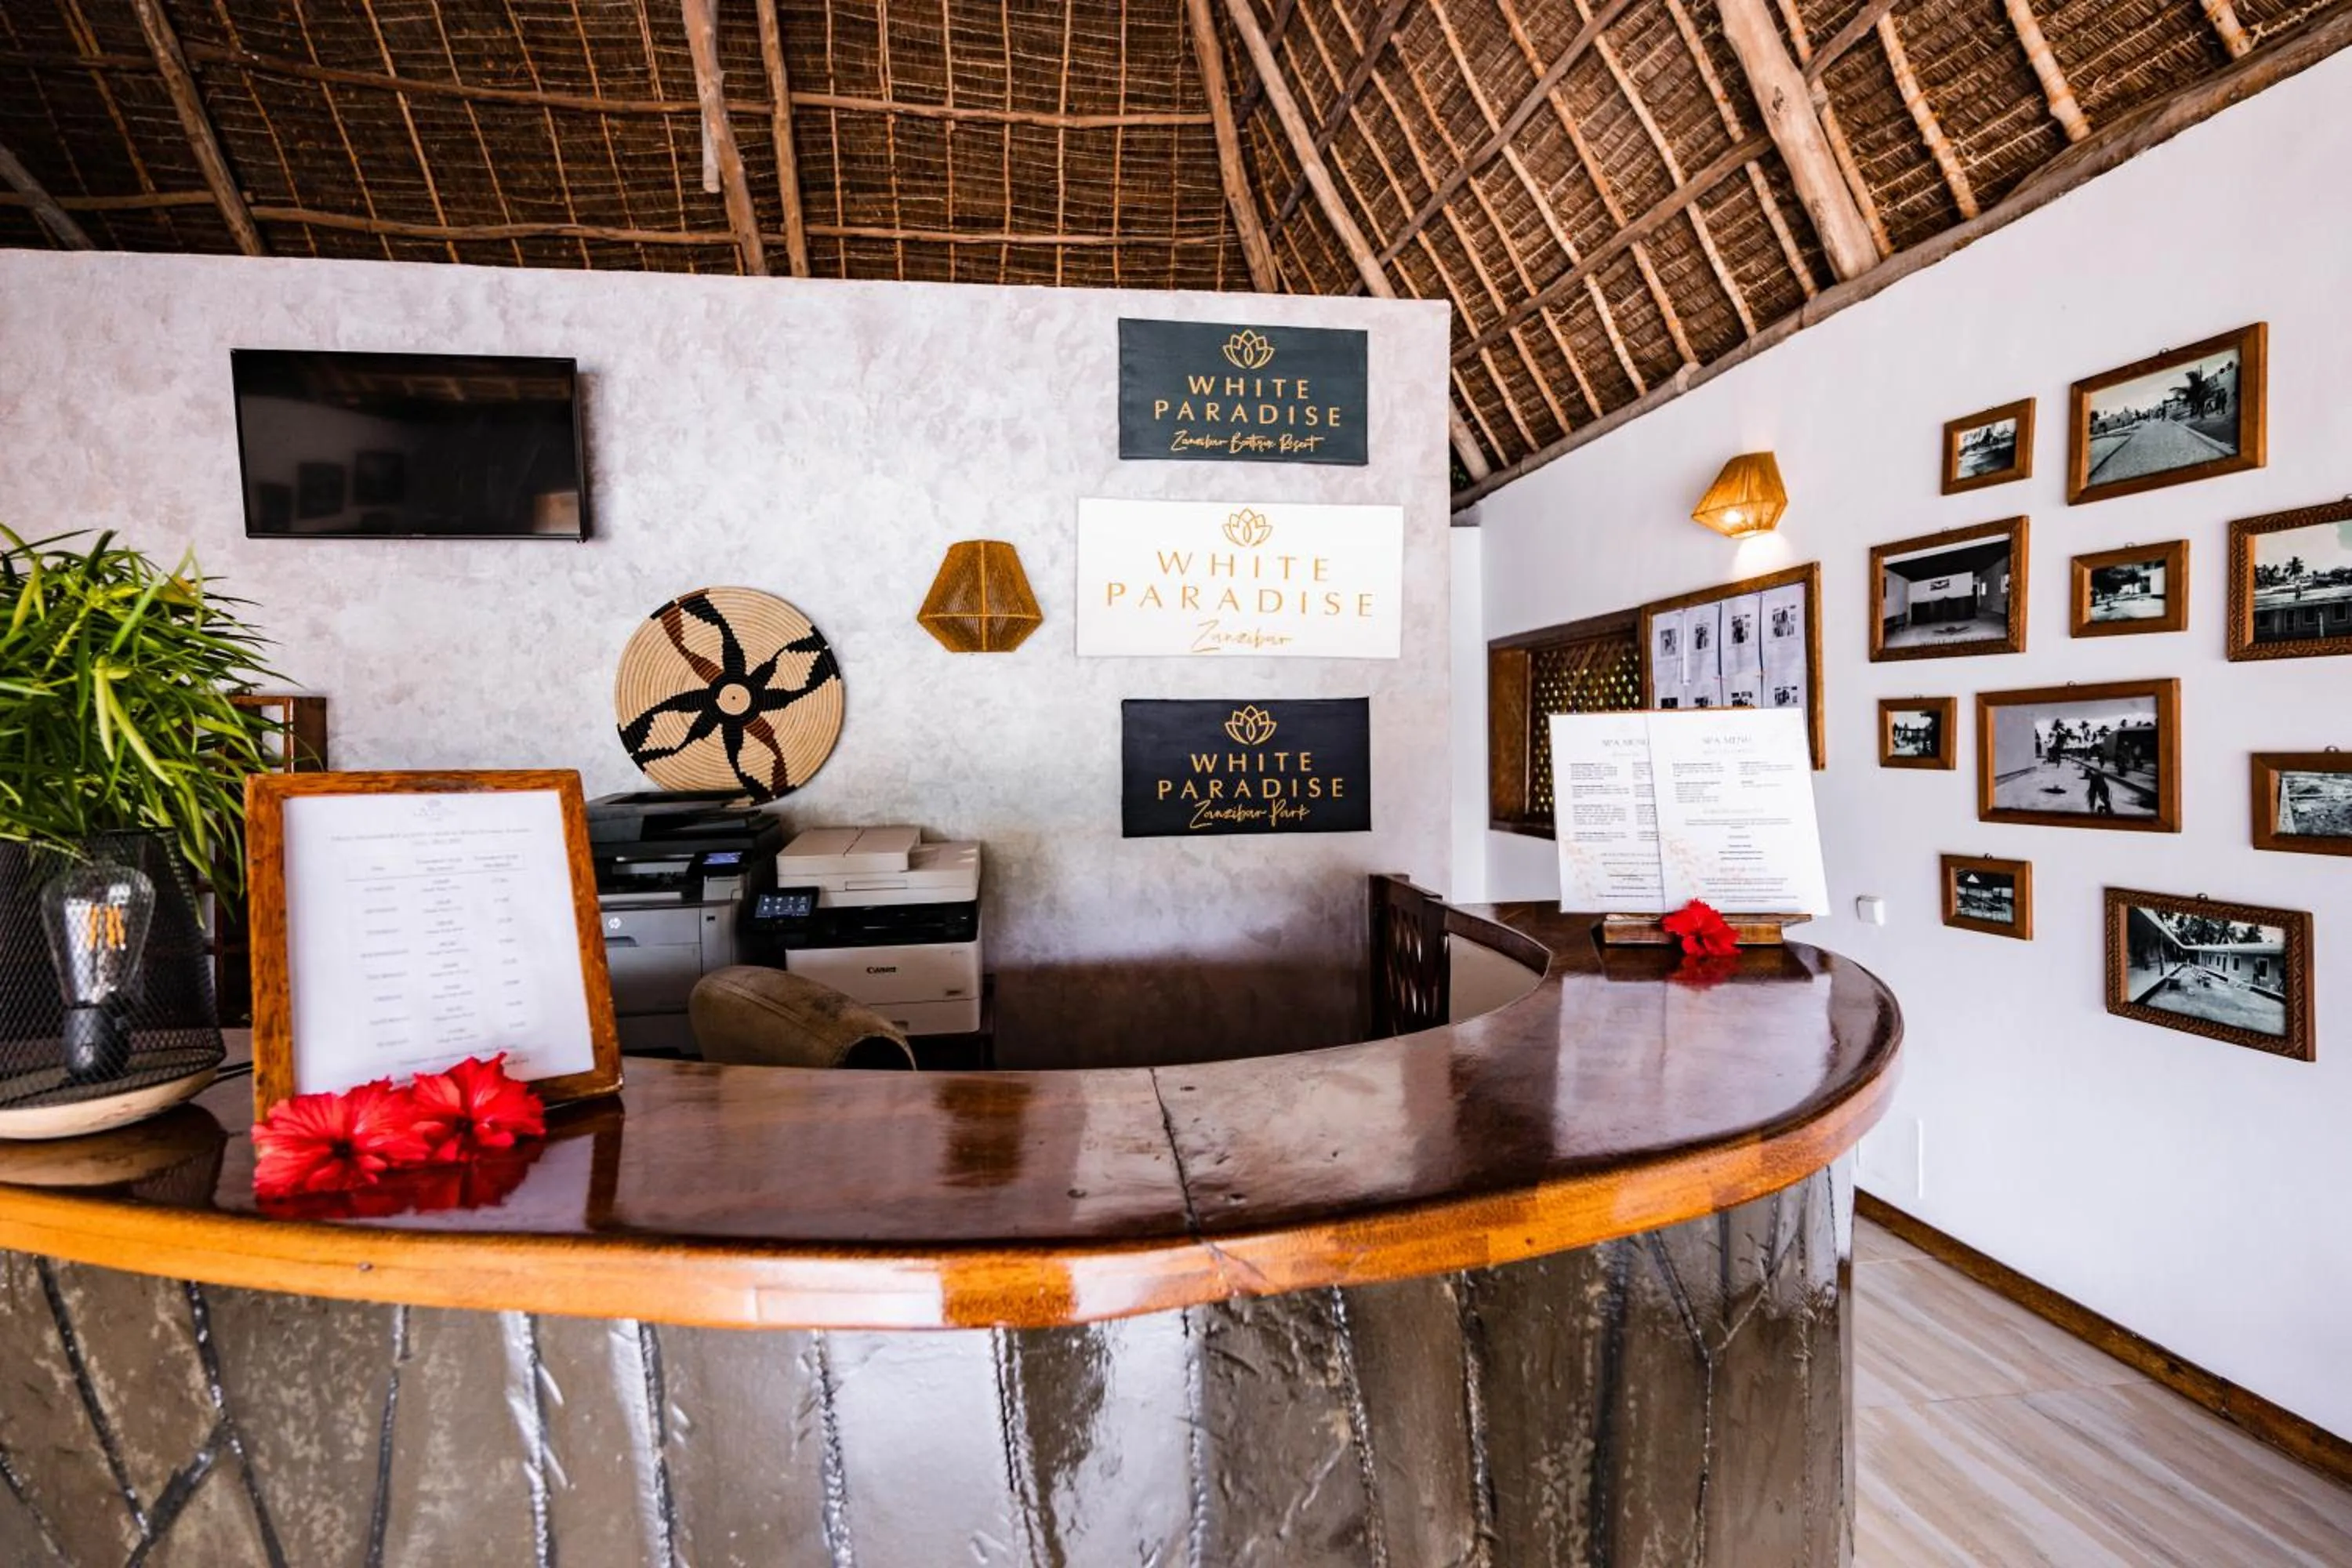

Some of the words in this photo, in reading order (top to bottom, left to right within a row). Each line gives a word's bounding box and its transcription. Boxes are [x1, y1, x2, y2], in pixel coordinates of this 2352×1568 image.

[1188, 375, 1310, 400] WHITE
[1154, 399, 1341, 427] PARADISE
[1156, 550, 1330, 583] WHITE
[1106, 581, 1374, 618] PARADISE
[1190, 619, 1294, 653] Zanzibar
[1189, 751, 1312, 775] WHITE
[1157, 776, 1345, 800] PARADISE
[1189, 799, 1268, 829] Zanzibar
[1267, 798, 1311, 828] Park
